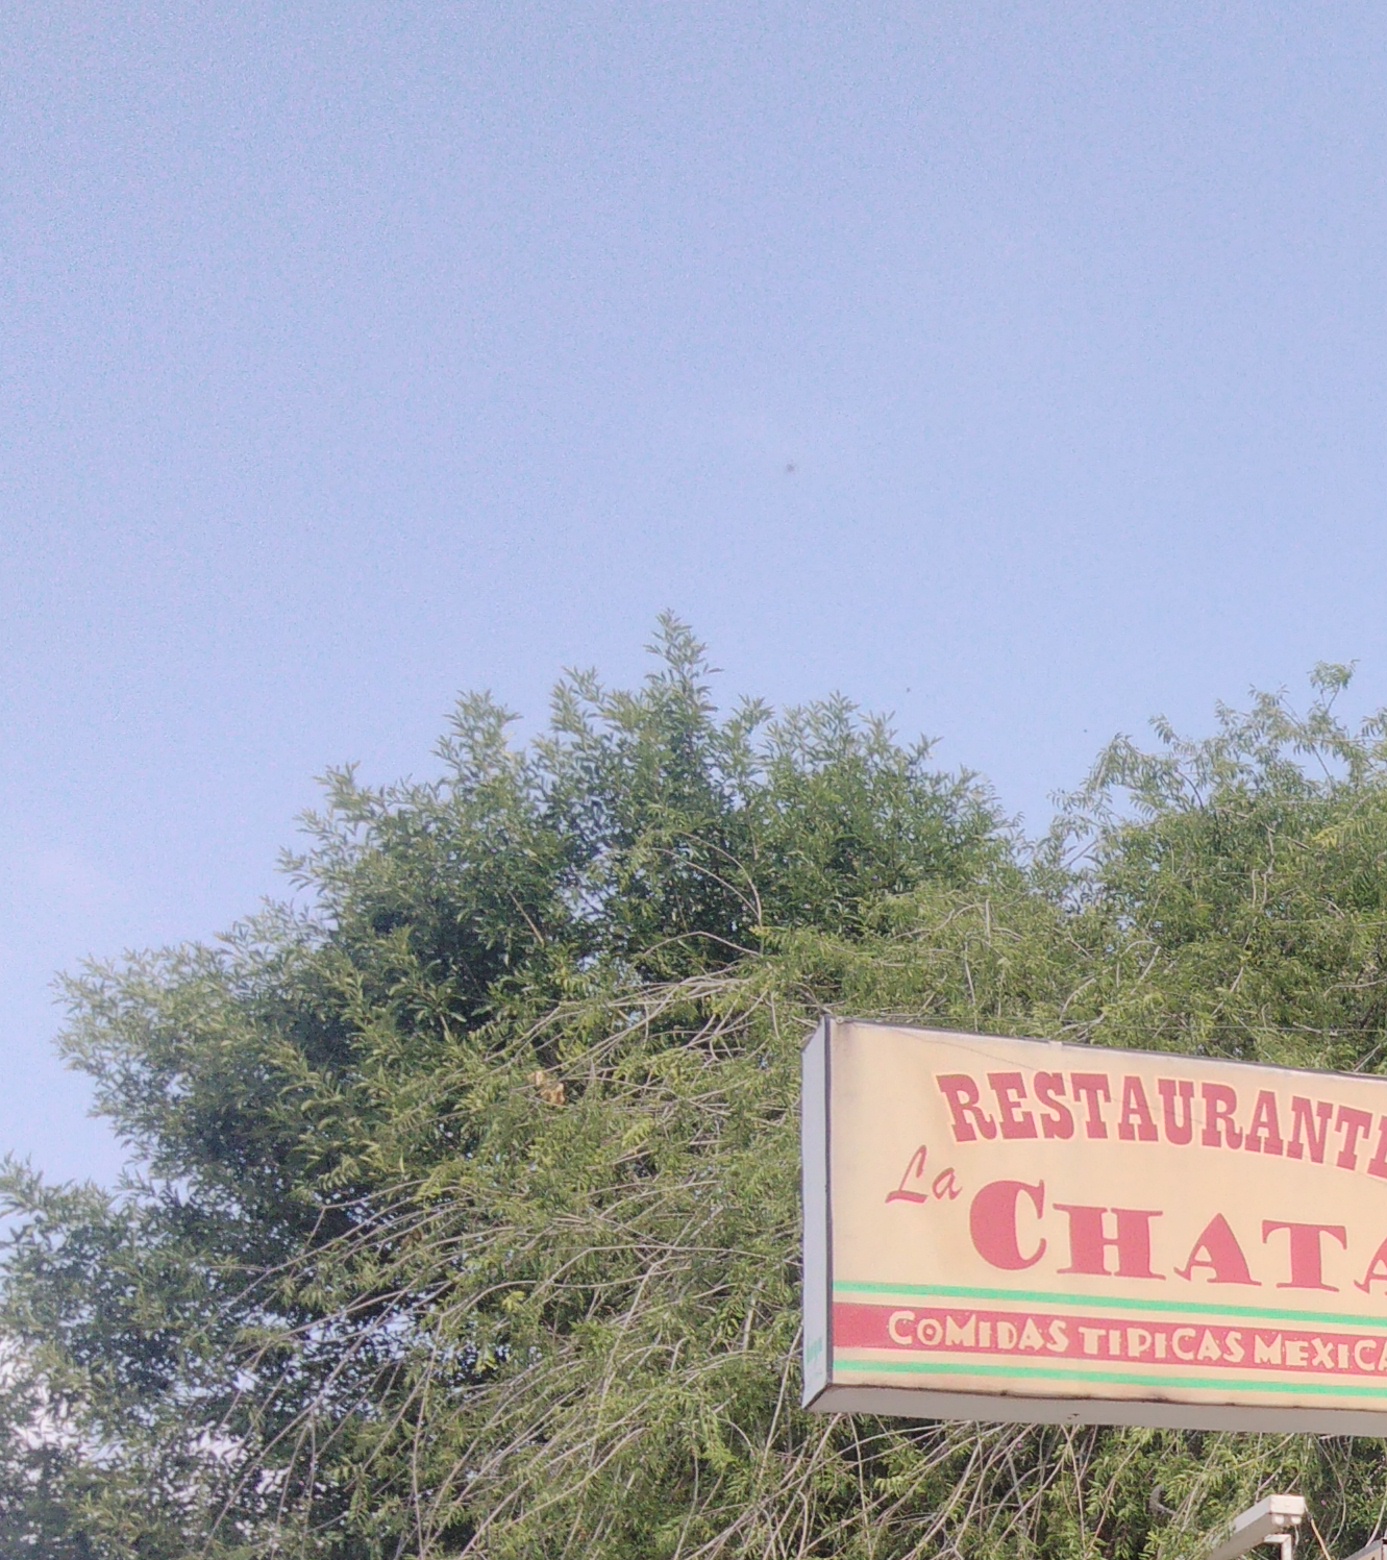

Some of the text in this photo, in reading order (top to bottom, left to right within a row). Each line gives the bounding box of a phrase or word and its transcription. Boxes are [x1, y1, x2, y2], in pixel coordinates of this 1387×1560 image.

[886, 1144, 963, 1203] La
[888, 1310, 1070, 1353] COMIDAS
[1077, 1325, 1247, 1364] TIPICAS
